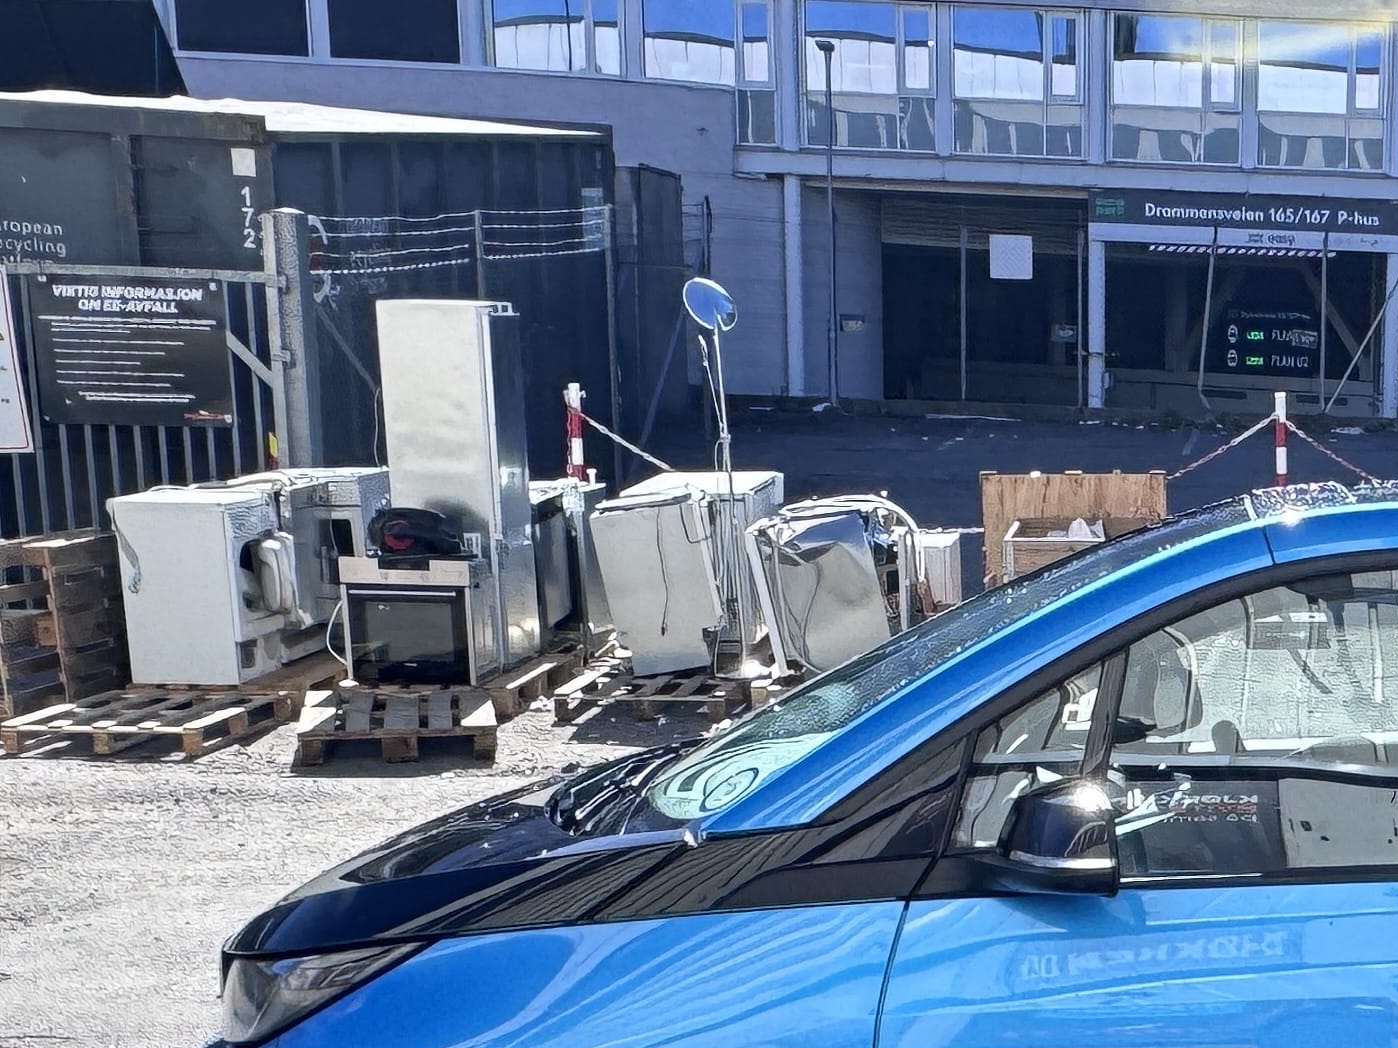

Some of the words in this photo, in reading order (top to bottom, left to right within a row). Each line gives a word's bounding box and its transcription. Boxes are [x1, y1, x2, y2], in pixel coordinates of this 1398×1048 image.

[241, 186, 257, 249] 172
[1268, 207, 1329, 225] 165/167
[1337, 212, 1380, 227] P-hus
[0, 220, 63, 236] ropean
